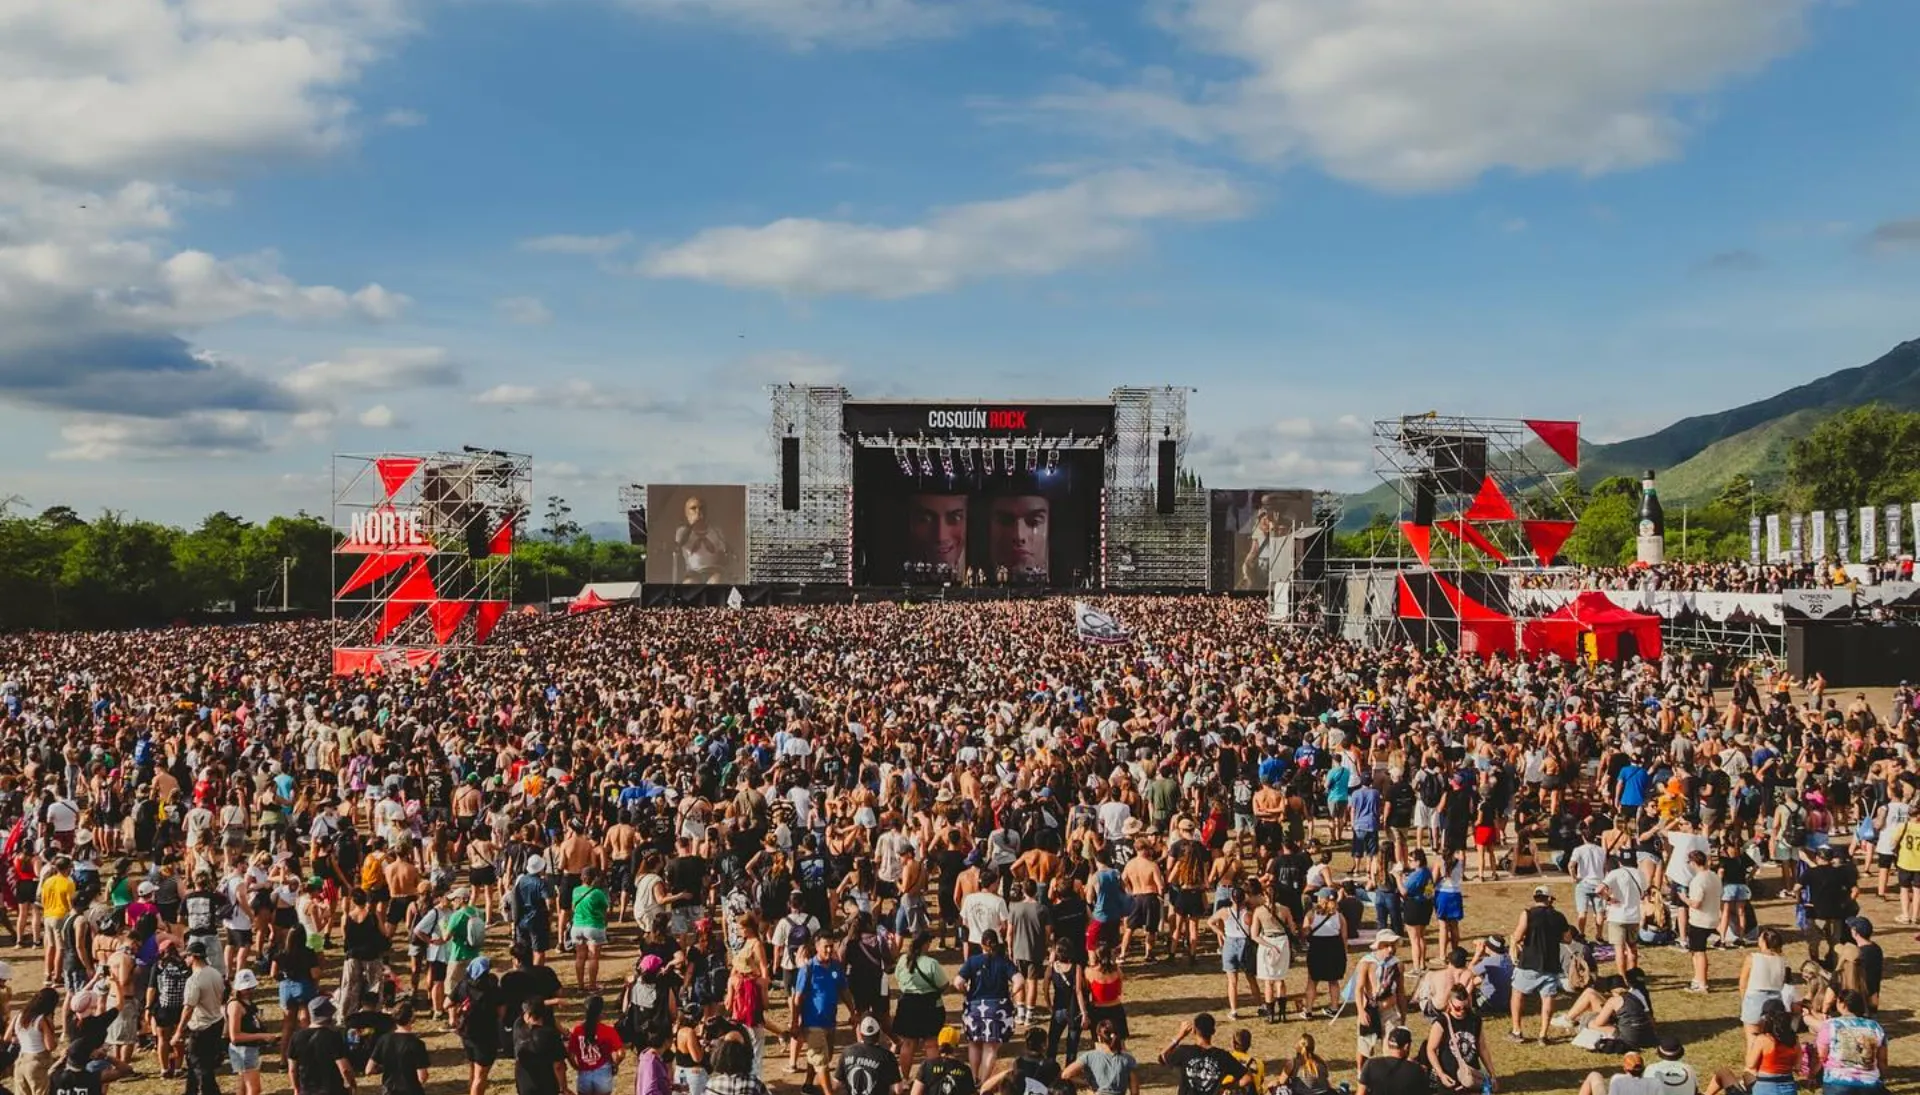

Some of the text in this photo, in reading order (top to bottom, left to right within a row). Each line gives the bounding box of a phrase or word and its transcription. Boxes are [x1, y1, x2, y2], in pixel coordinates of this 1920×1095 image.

[928, 407, 1027, 429] COSQUÍN ROCK
[351, 511, 423, 545] NORTE
